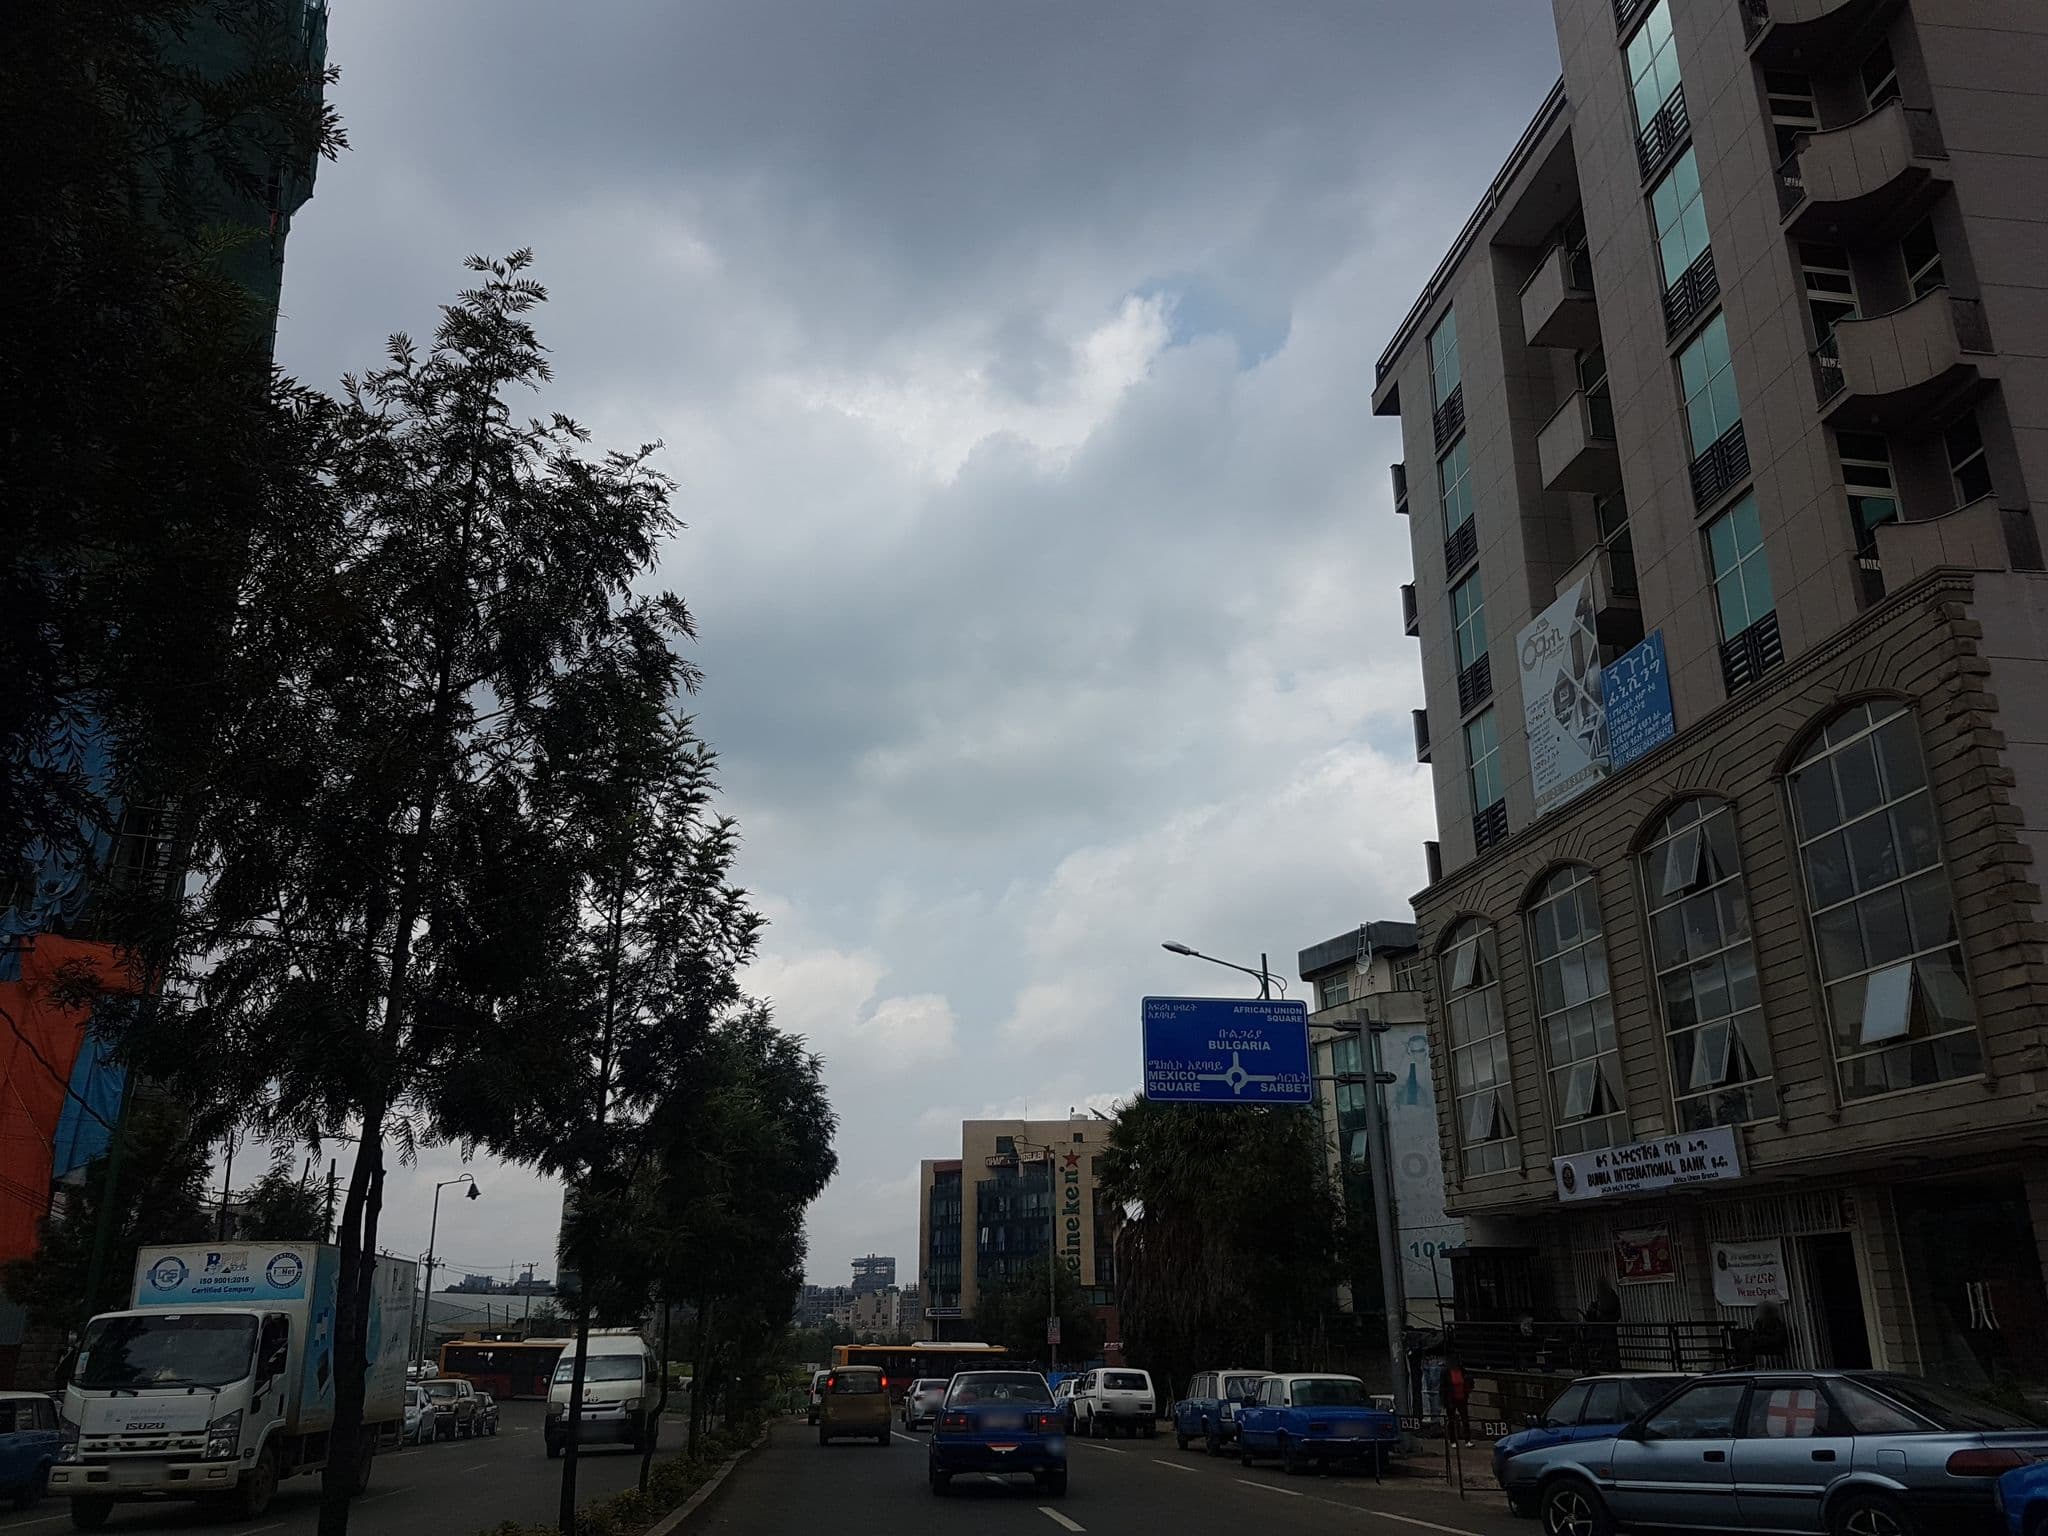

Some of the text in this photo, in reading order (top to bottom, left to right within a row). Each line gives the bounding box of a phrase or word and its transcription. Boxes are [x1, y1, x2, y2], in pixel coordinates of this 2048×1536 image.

[1233, 1006, 1303, 1015] AFRICAN UNION
[1267, 1015, 1303, 1023] SQUARE
[1219, 1029, 1263, 1040] ቡልጋሪያ
[1208, 1040, 1271, 1051] BULGARIA
[1187, 1061, 1223, 1072] አደባባይ
[1148, 1071, 1196, 1081] MEXICO
[1149, 1082, 1201, 1092] SQUARE
[1260, 1083, 1309, 1093] SARBET
[1614, 1160, 1676, 1183] INTERNATIONAL
[1680, 1155, 1707, 1173] BANK
[1701, 1171, 1719, 1180] Branch
[200, 1276, 250, 1285] ISO 9001:2015
[191, 1286, 256, 1294] Certified Company
[126, 1422, 165, 1431] ISUZU
[1400, 1417, 1421, 1430] BIB
[1485, 1422, 1509, 1436] BIB
